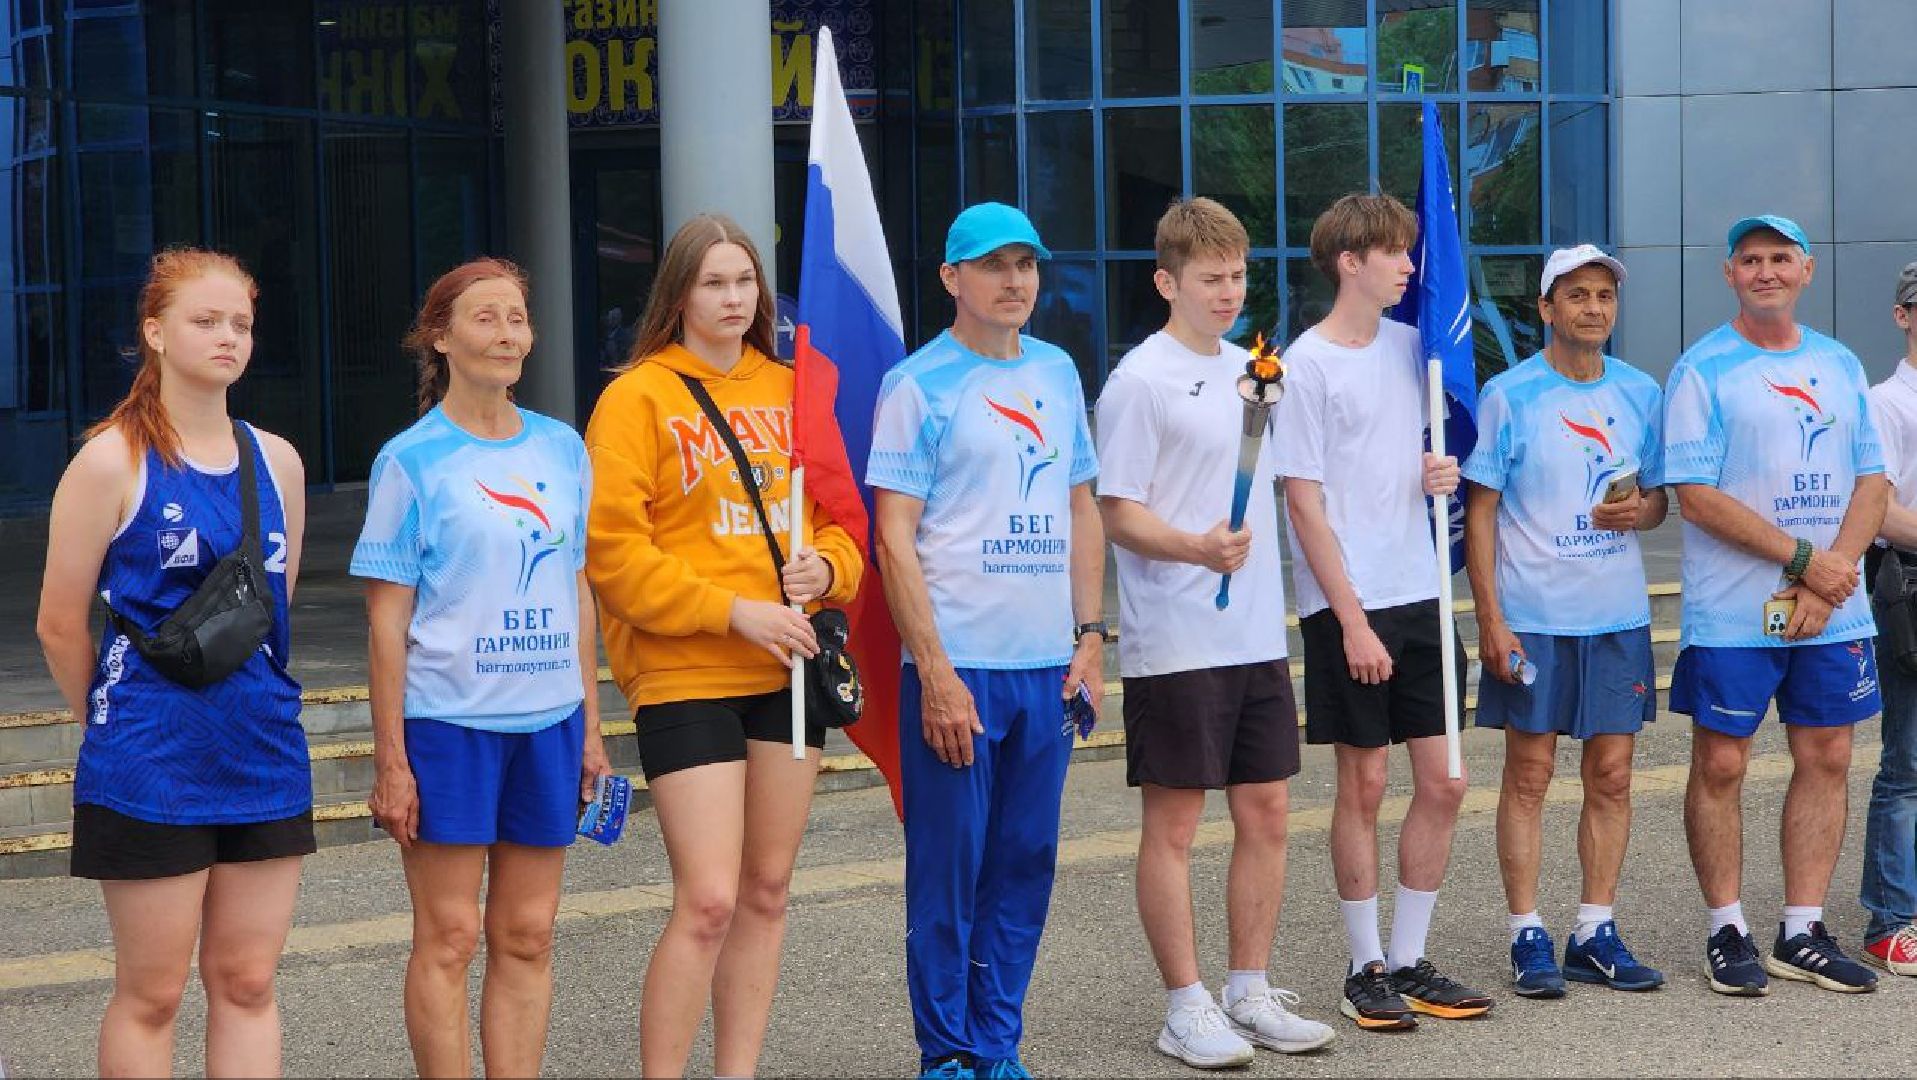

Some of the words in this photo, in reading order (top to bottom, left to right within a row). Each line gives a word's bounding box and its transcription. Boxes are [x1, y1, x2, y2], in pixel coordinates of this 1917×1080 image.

[564, 0, 658, 30] азин
[667, 404, 793, 496] MAV
[1793, 473, 1832, 492] БЕГ
[1009, 514, 1054, 534] БЕГ
[264, 532, 287, 573] 2
[503, 607, 553, 630] БЕГ
[475, 631, 570, 654] ГАРМОНИИ
